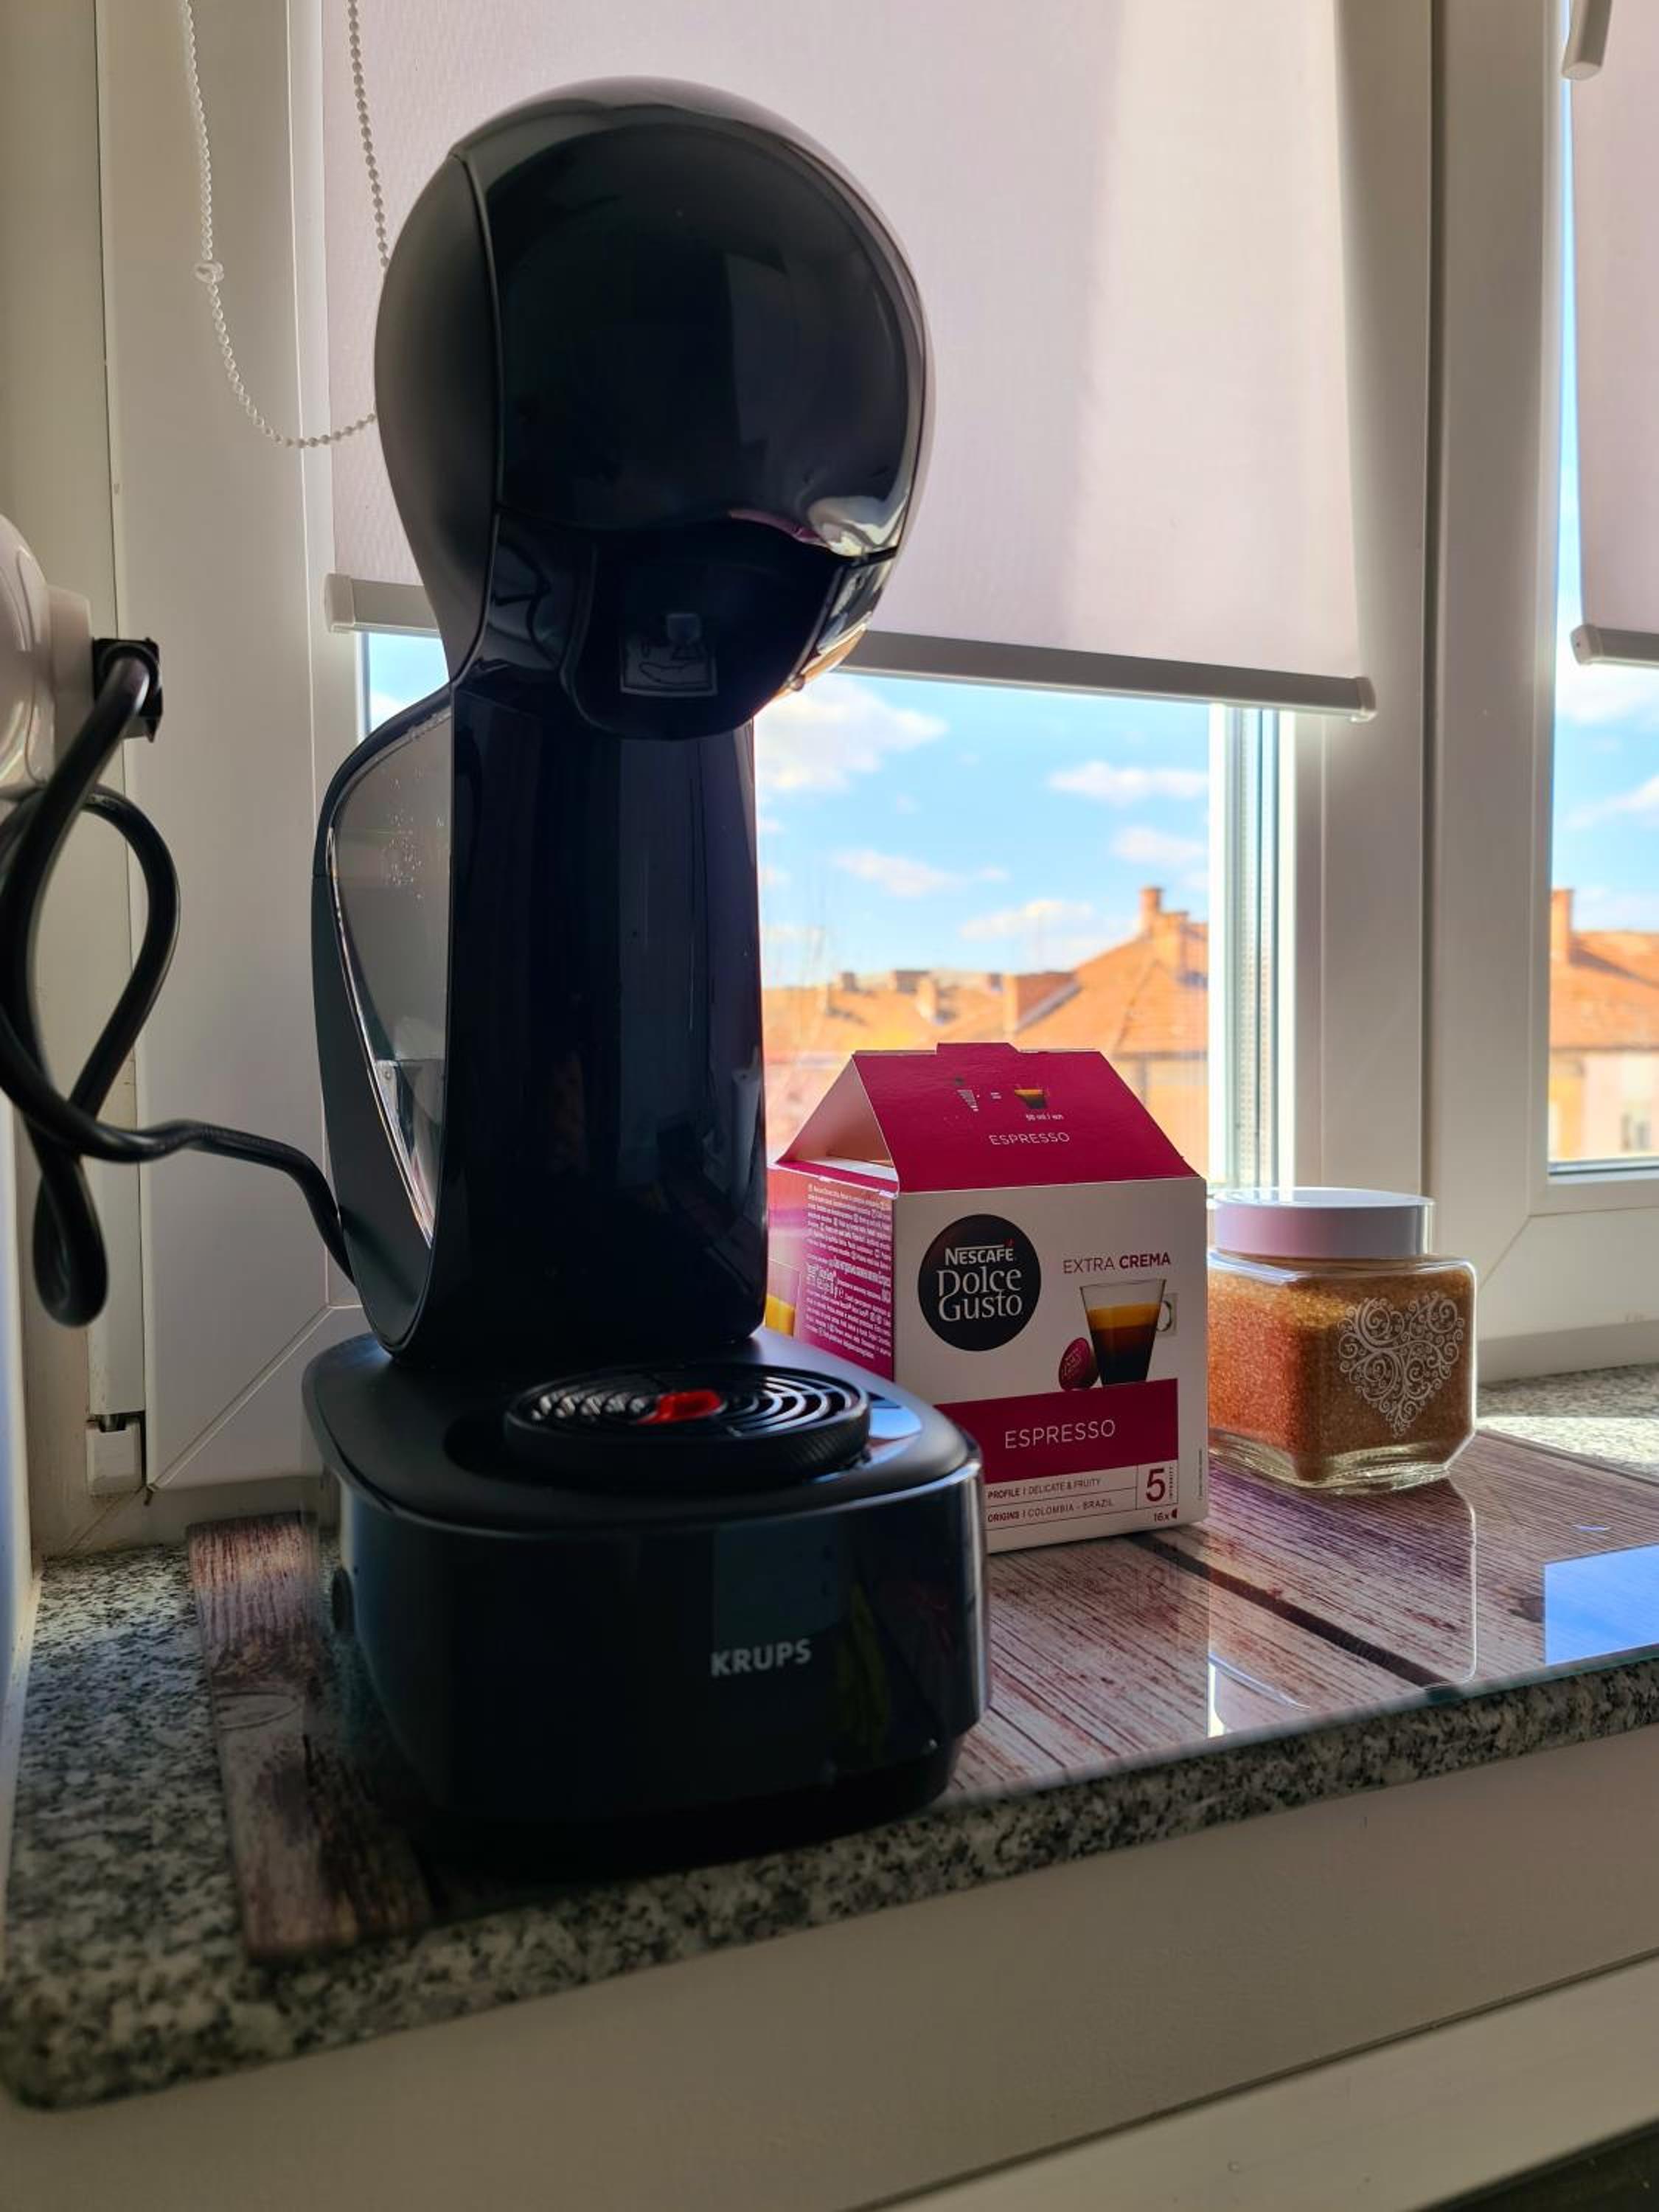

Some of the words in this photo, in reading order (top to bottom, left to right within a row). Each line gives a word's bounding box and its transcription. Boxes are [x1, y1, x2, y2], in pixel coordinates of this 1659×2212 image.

[989, 1132, 1070, 1145] ESPRESSO
[1063, 1256, 1115, 1273] EXTRA
[1119, 1252, 1171, 1269] CREMA
[936, 1266, 1022, 1297] Dolce
[939, 1291, 1023, 1322] Gusto
[1004, 1419, 1116, 1449] ESPRESSO
[987, 1487, 1020, 1499] PROFILE
[1029, 1481, 1066, 1495] DELICATE
[1074, 1478, 1101, 1489] FRUITY
[1146, 1468, 1165, 1502] 5
[1028, 1503, 1074, 1517] COLOMBIA
[711, 1638, 812, 1677] KRUPS
